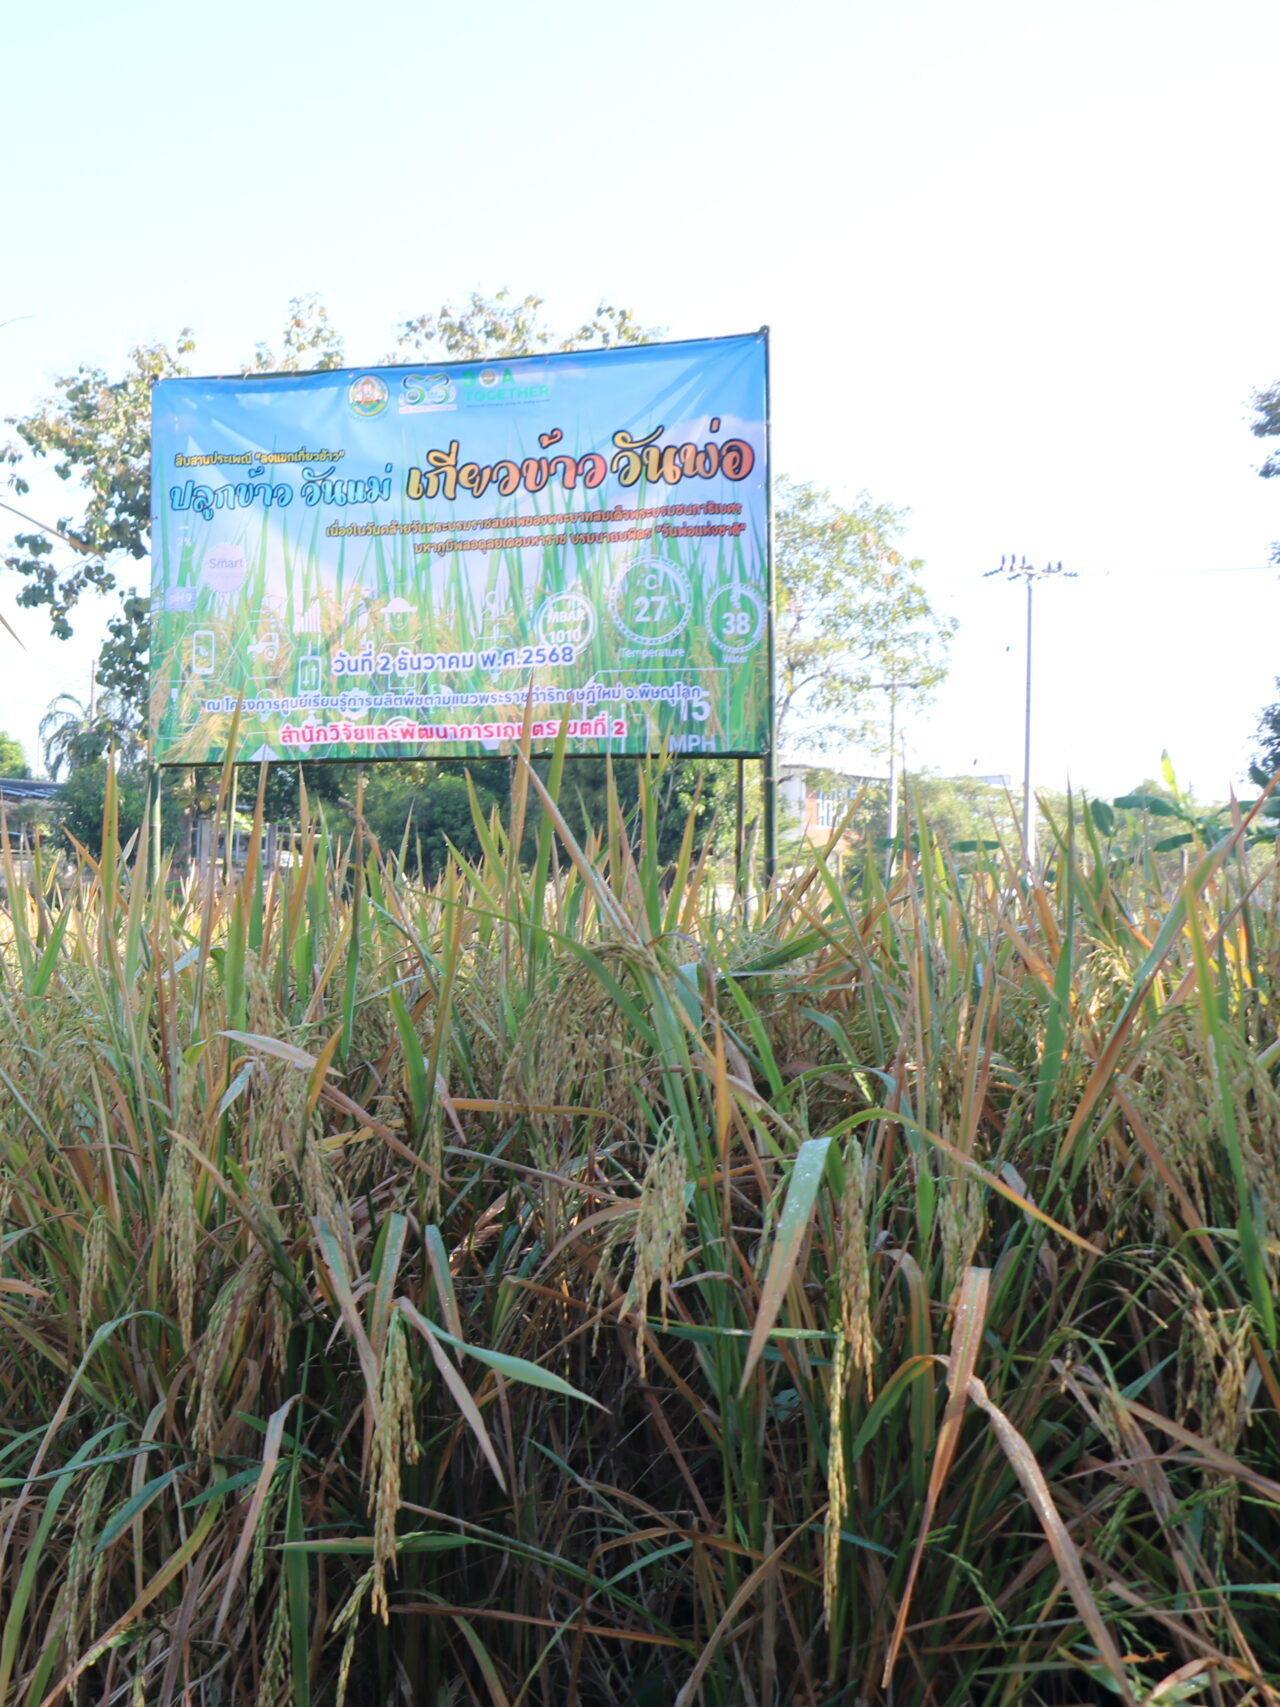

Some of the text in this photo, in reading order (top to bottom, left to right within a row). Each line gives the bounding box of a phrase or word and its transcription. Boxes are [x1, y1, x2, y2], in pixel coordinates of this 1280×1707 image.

[464, 385, 549, 401] TOGETHER
[170, 466, 294, 521] ปลูกข้าว
[300, 463, 392, 506] วันแม่
[209, 558, 243, 569] Smart
[634, 596, 669, 622] 27
[722, 612, 750, 635] 38
[334, 644, 574, 672] วันที่ 2 ธันวาคม พ.ศ.2568
[207, 700, 220, 711] ณ
[625, 683, 700, 705] จ.พิษณุโลก
[614, 721, 625, 736] 2
[668, 734, 716, 752] MPH
